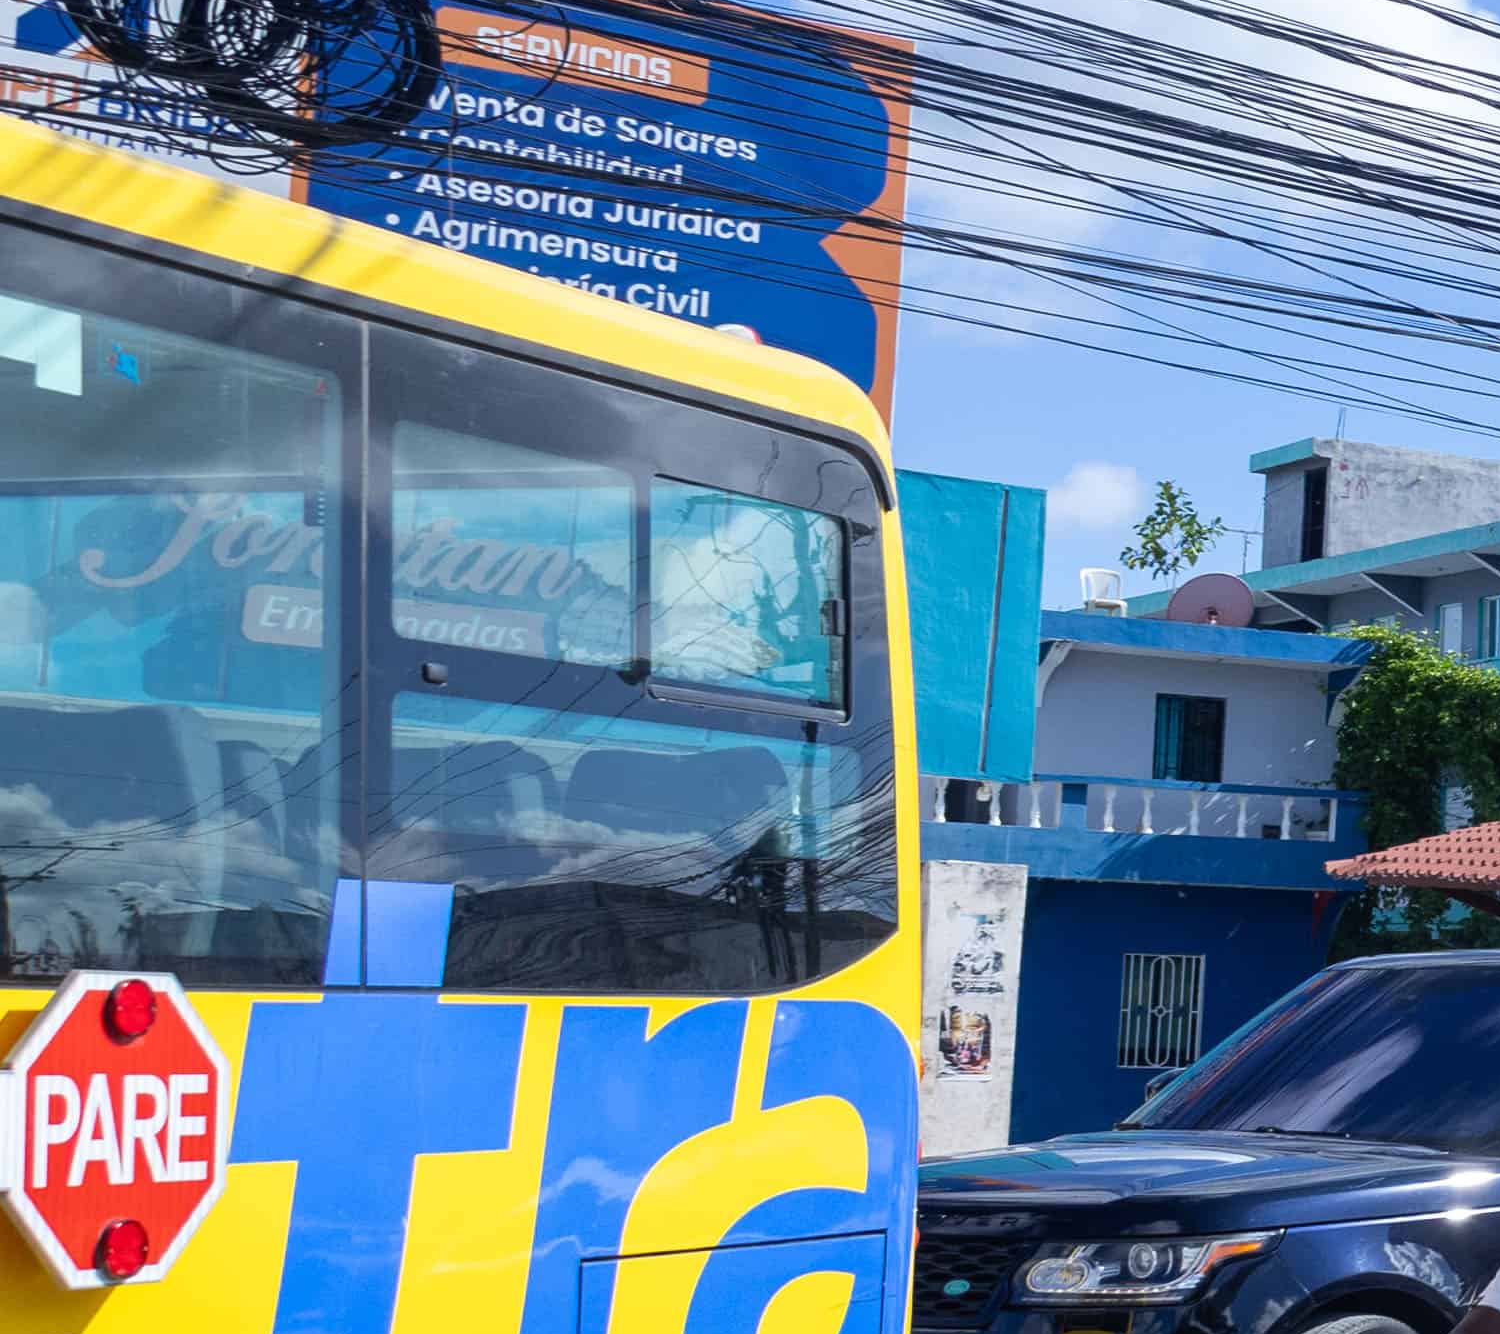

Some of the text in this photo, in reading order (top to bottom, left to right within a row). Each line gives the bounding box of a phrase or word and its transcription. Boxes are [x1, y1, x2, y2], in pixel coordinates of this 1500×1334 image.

[476, 25, 672, 86] SERVICIOS
[429, 85, 757, 162] Venta de Solares
[413, 210, 679, 273] Agrimensura
[626, 282, 710, 318] Civil
[33, 1071, 210, 1189] PARE
